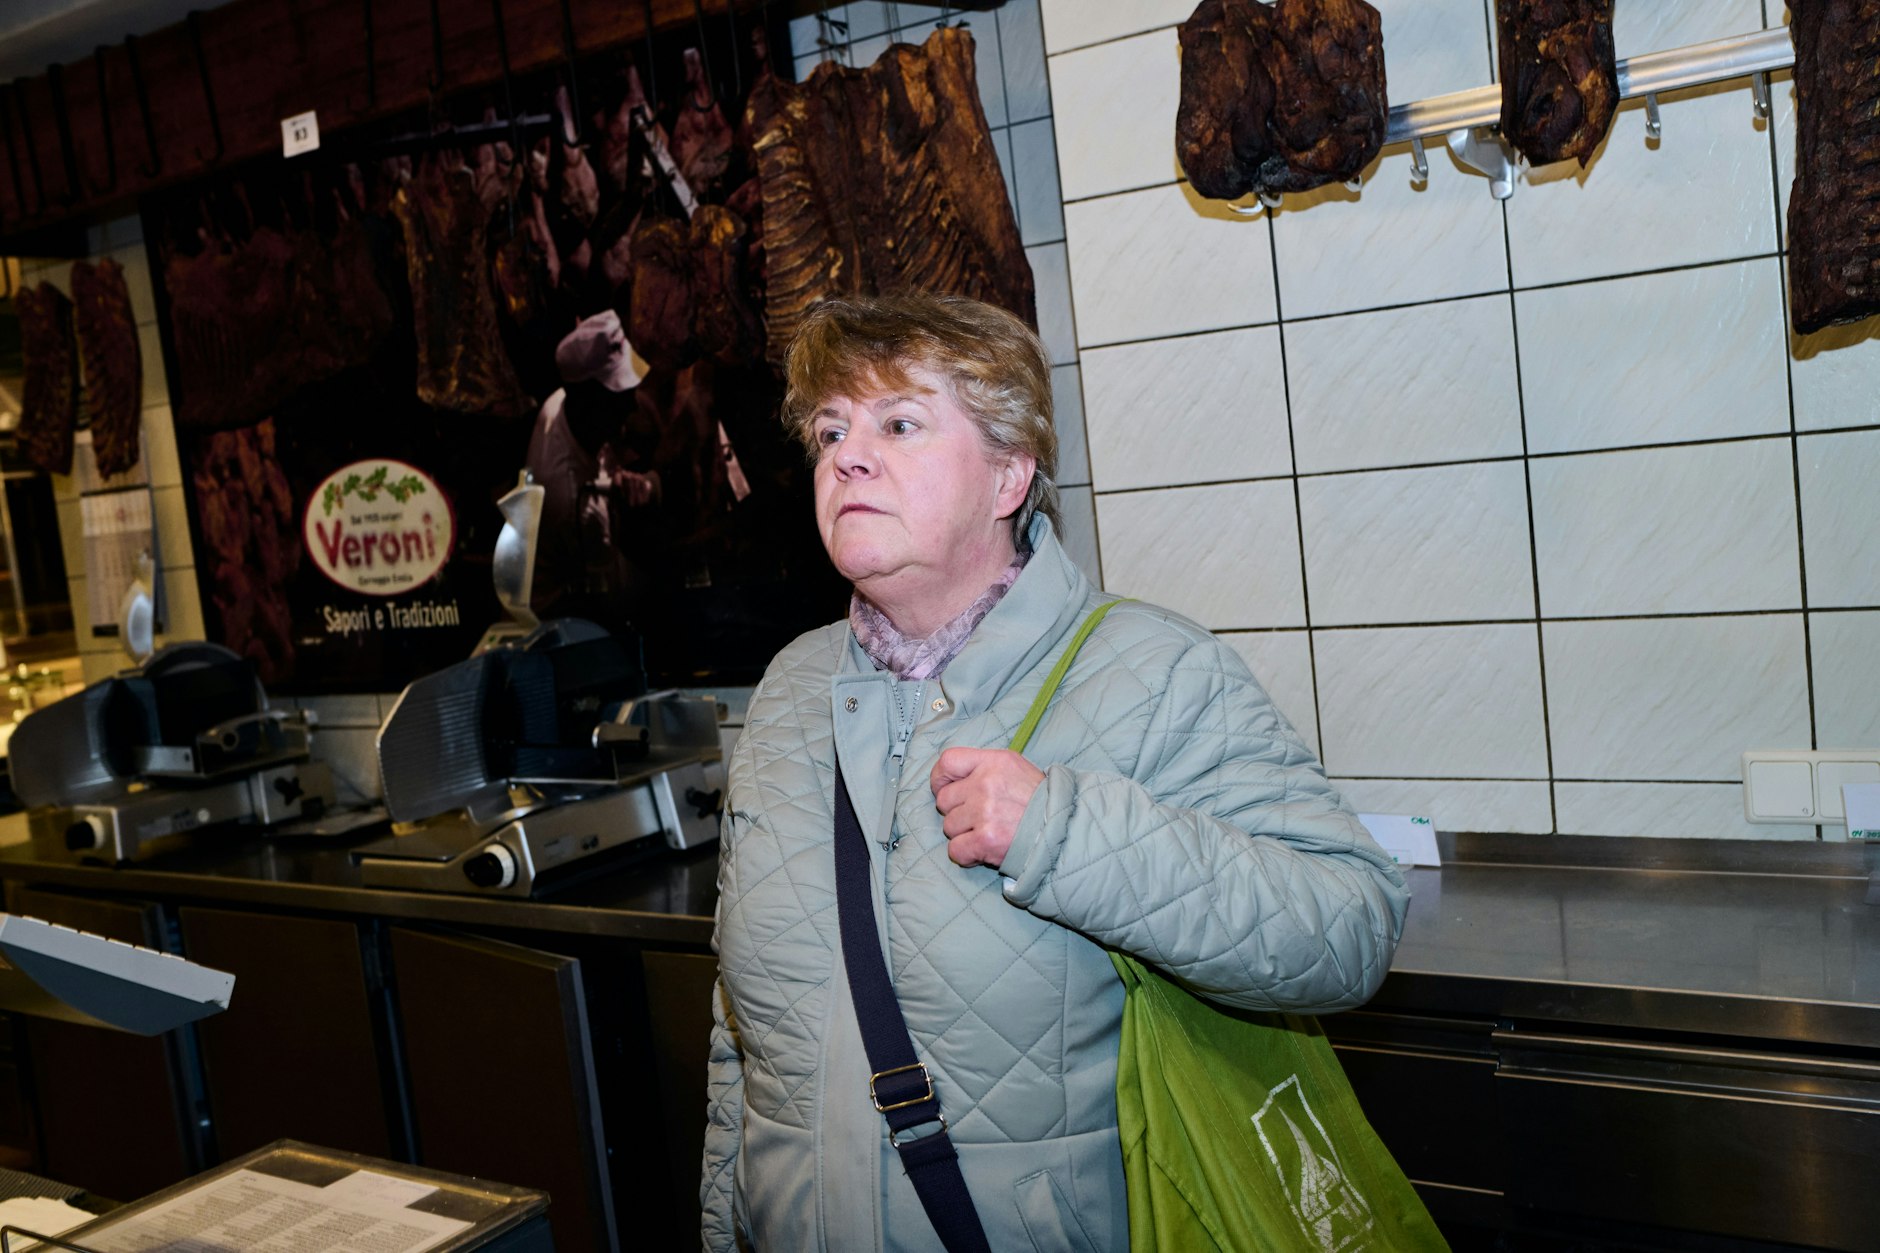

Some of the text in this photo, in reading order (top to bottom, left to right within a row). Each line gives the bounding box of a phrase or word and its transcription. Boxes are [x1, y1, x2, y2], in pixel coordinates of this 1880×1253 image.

[315, 511, 435, 569] Veroni
[323, 599, 460, 638] Sapori e Tradizioni
